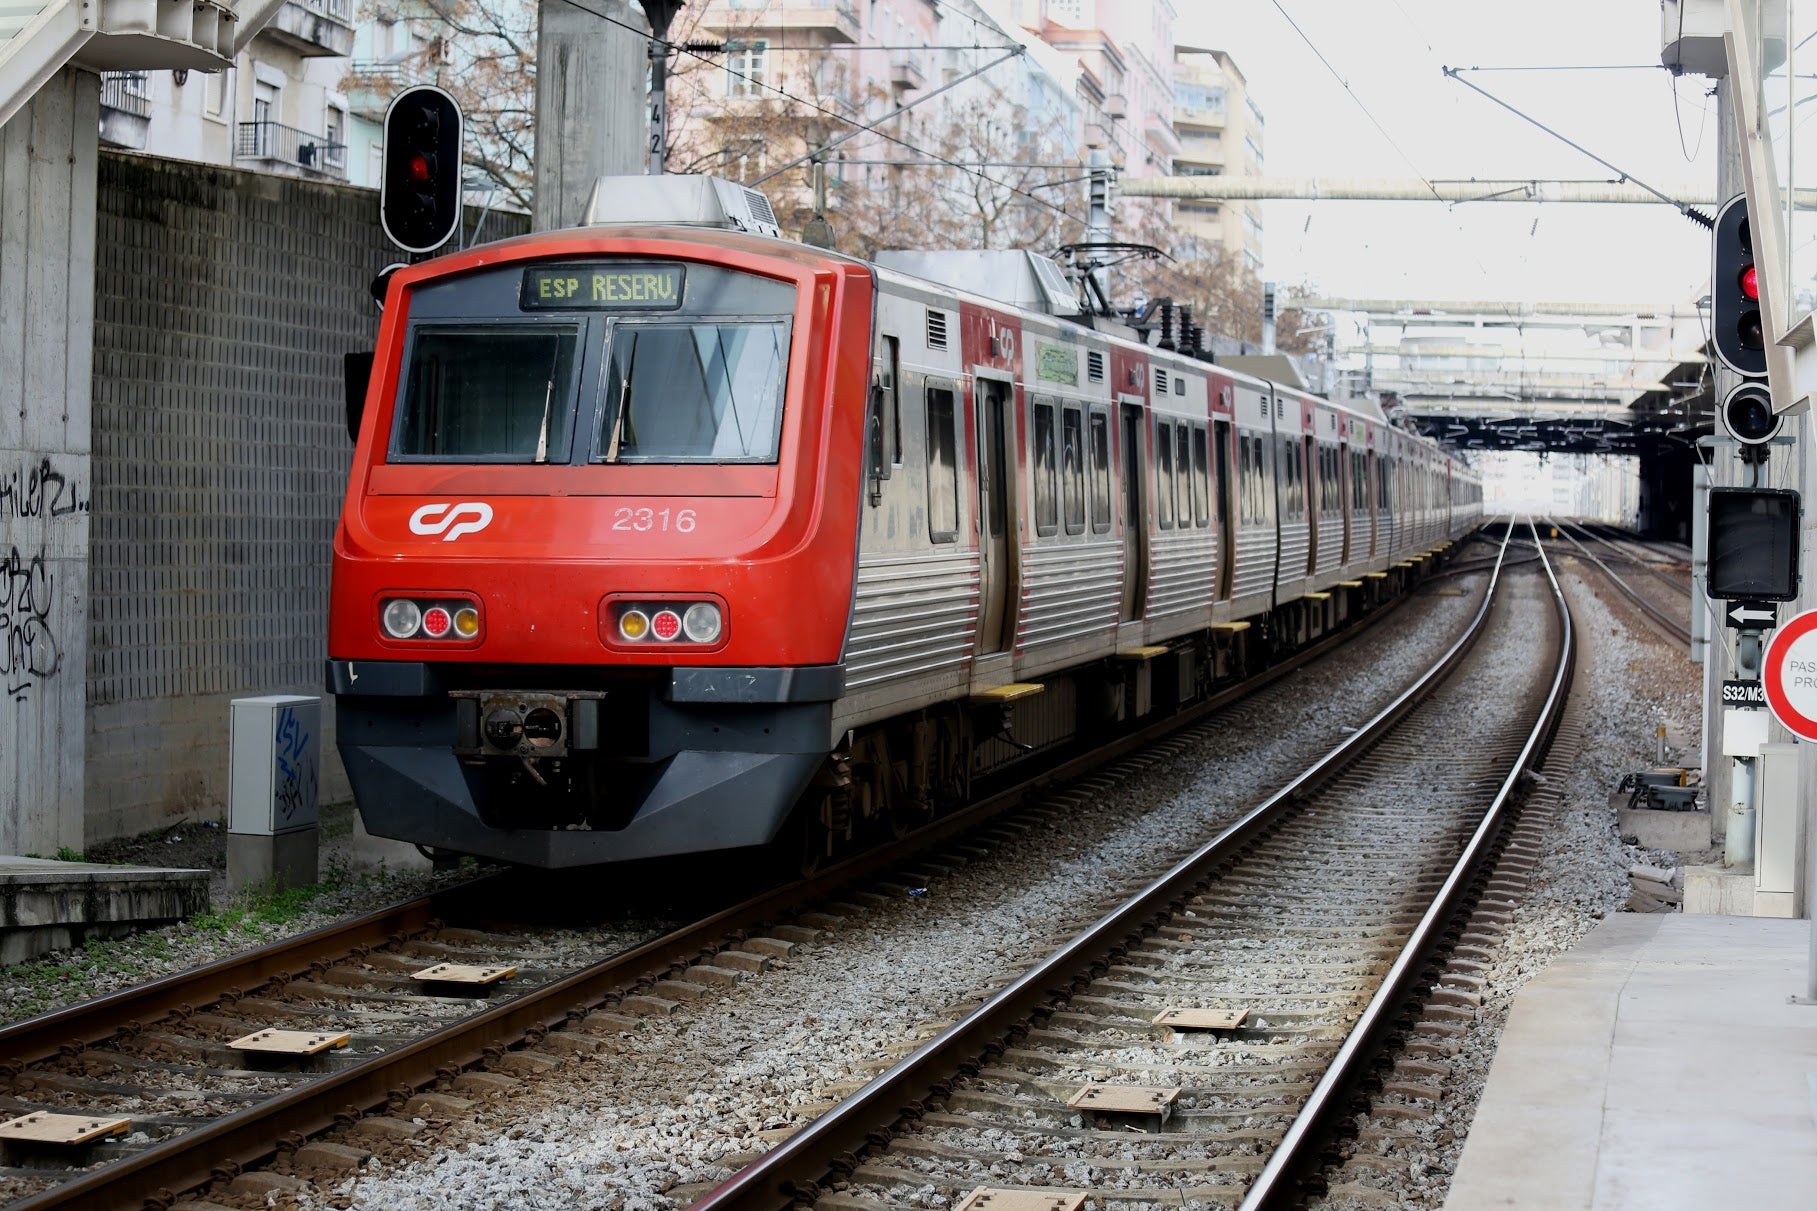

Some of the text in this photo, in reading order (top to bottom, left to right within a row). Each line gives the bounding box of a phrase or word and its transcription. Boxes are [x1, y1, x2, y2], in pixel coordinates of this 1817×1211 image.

[539, 278, 579, 298] ESP
[612, 507, 697, 533] 2316
[1723, 685, 1766, 702] S32/M3
